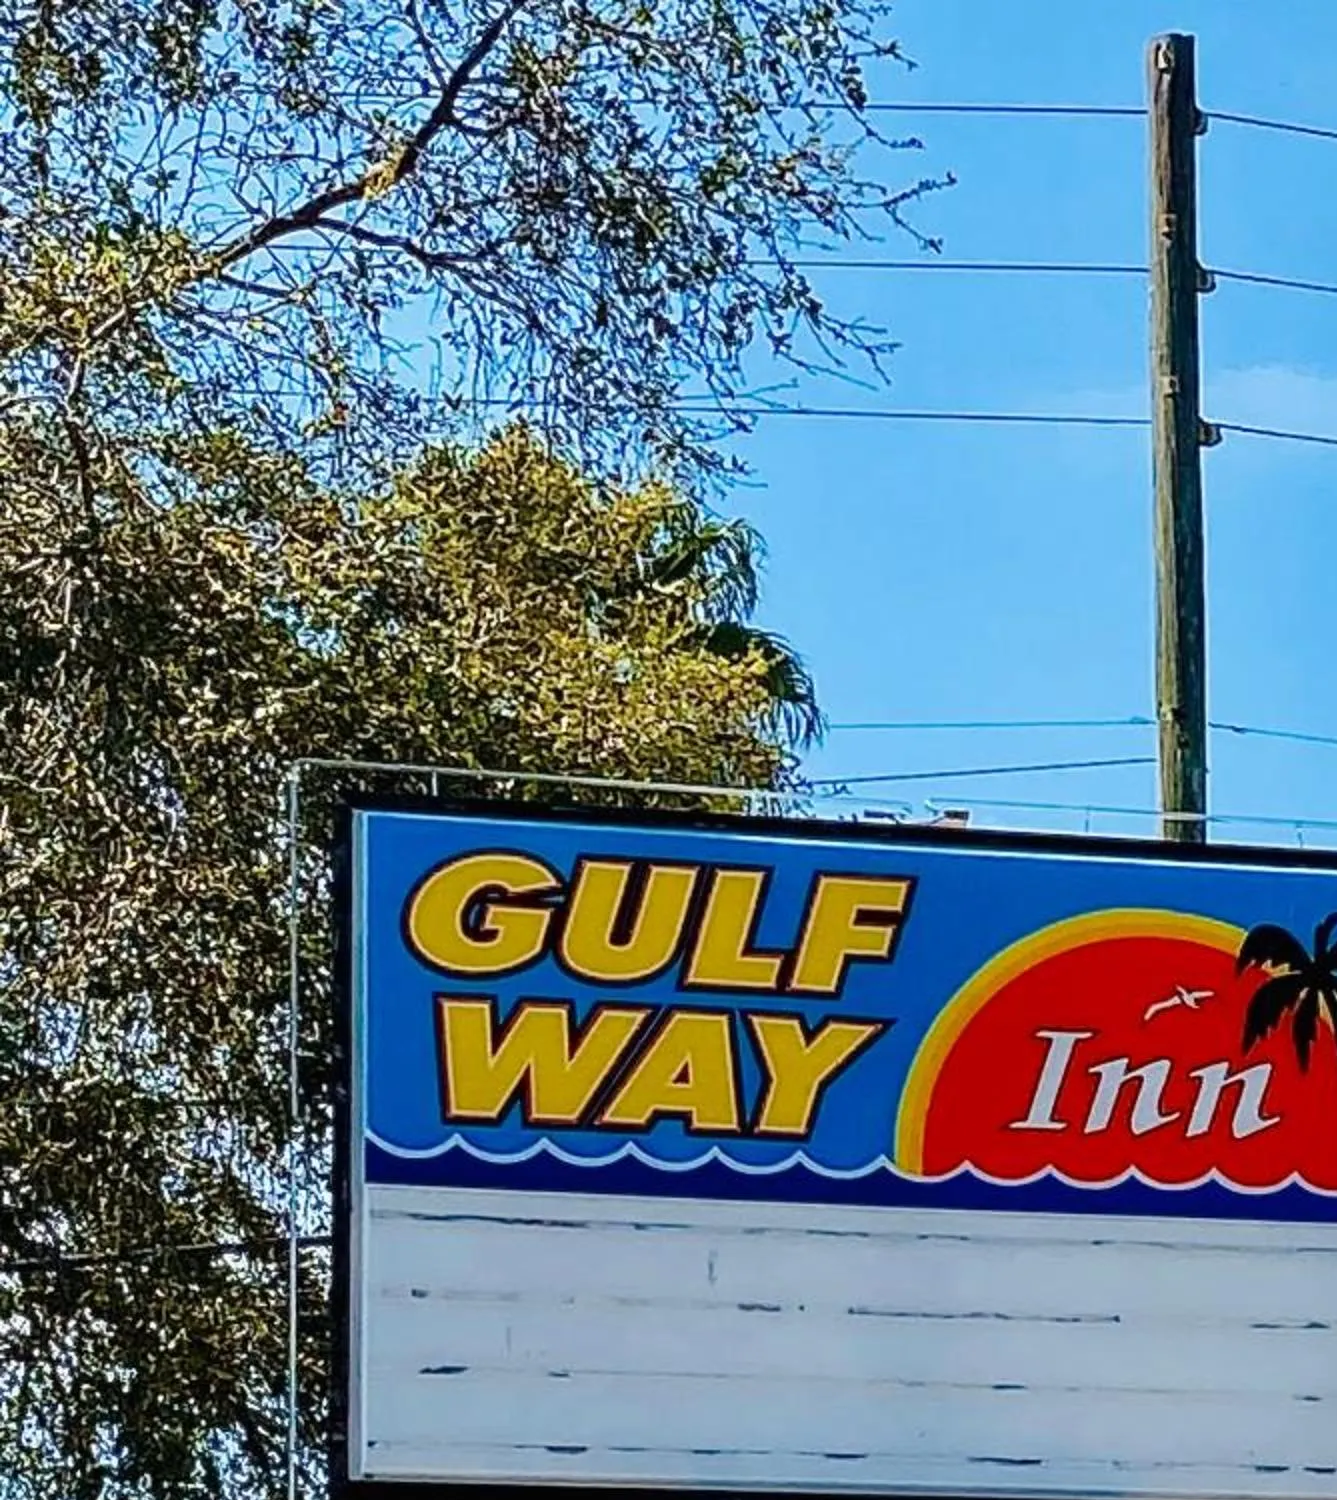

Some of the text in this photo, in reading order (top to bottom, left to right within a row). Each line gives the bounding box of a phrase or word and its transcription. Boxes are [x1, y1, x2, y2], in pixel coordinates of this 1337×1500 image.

[402, 847, 918, 998] GULF
[435, 995, 896, 1138] WAY
[1008, 1028, 1281, 1141] Inn
